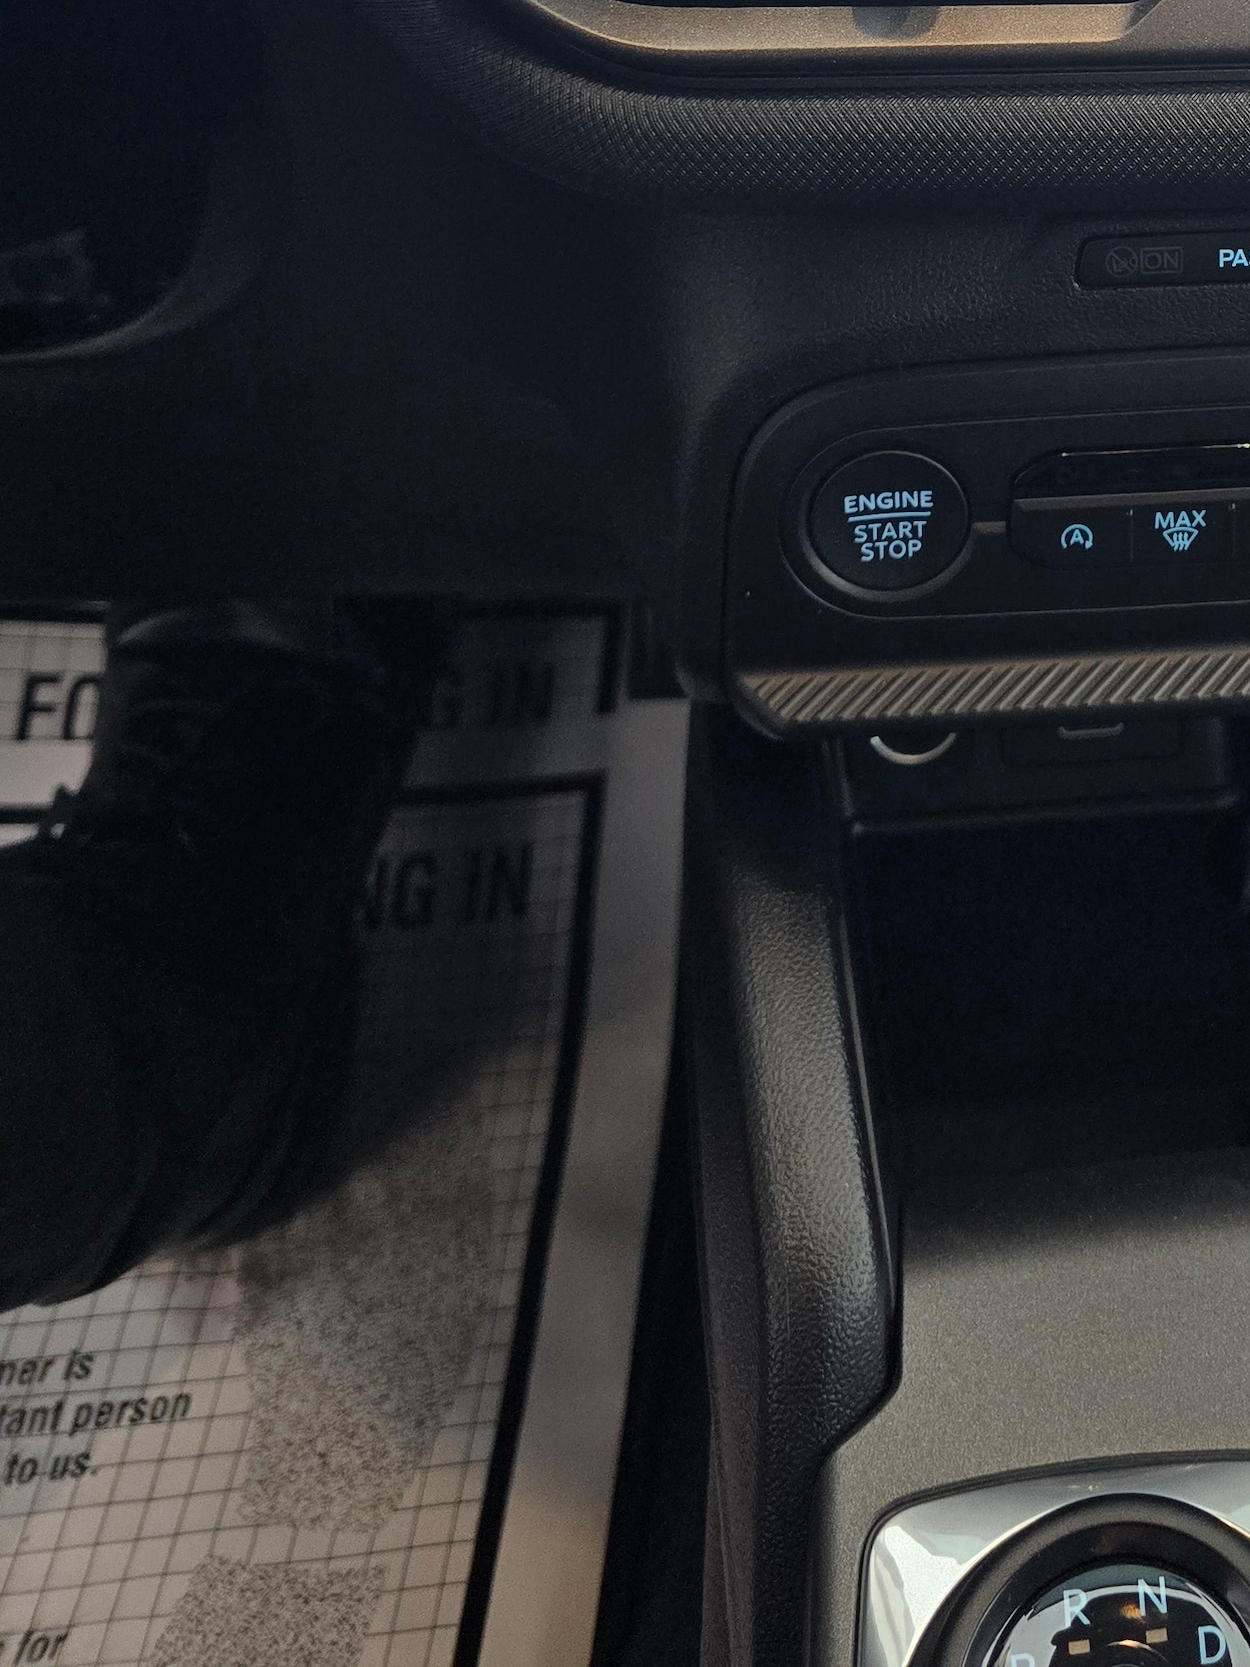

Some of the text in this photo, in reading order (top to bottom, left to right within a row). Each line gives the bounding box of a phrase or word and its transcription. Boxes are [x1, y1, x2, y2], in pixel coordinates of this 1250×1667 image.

[843, 490, 934, 514] ENGINE
[854, 520, 928, 544] START
[1154, 509, 1207, 530] MAX
[860, 539, 922, 562] STOP
[64, 1349, 94, 1380] is
[69, 1392, 192, 1437] person
[5, 1452, 38, 1485] to
[1062, 1588, 1091, 1628] R
[1137, 1576, 1168, 1617] N
[1197, 1625, 1227, 1665] D
